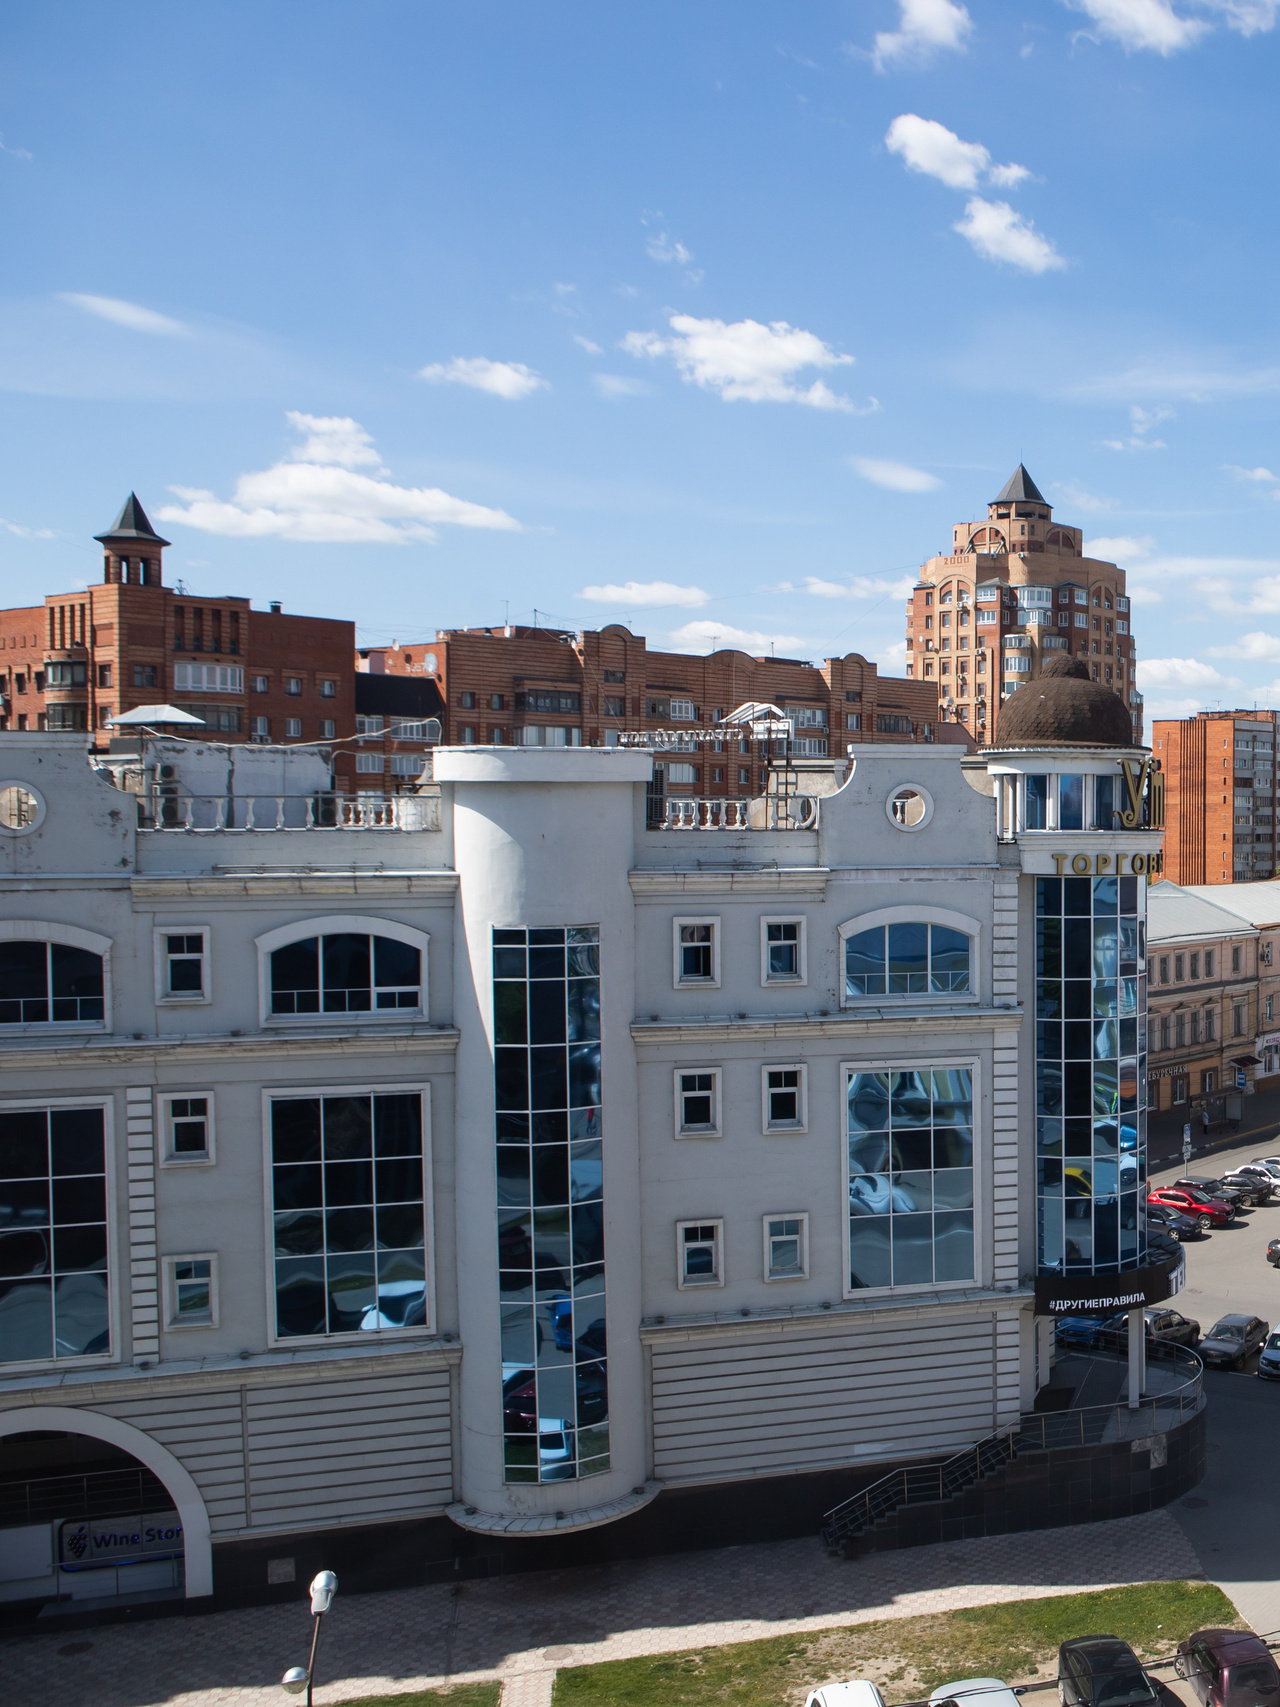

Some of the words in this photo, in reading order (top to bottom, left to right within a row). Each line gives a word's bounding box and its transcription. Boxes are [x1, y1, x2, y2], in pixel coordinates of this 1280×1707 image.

[1052, 850, 1163, 876] ТОРГОВ
[1148, 1064, 1187, 1080] ЕБУРЕЧНАЯ
[1049, 1292, 1146, 1311] #ДРУГИЕПРАВИЛА
[93, 1532, 140, 1549] Wine
[145, 1528, 183, 1542] Stor
